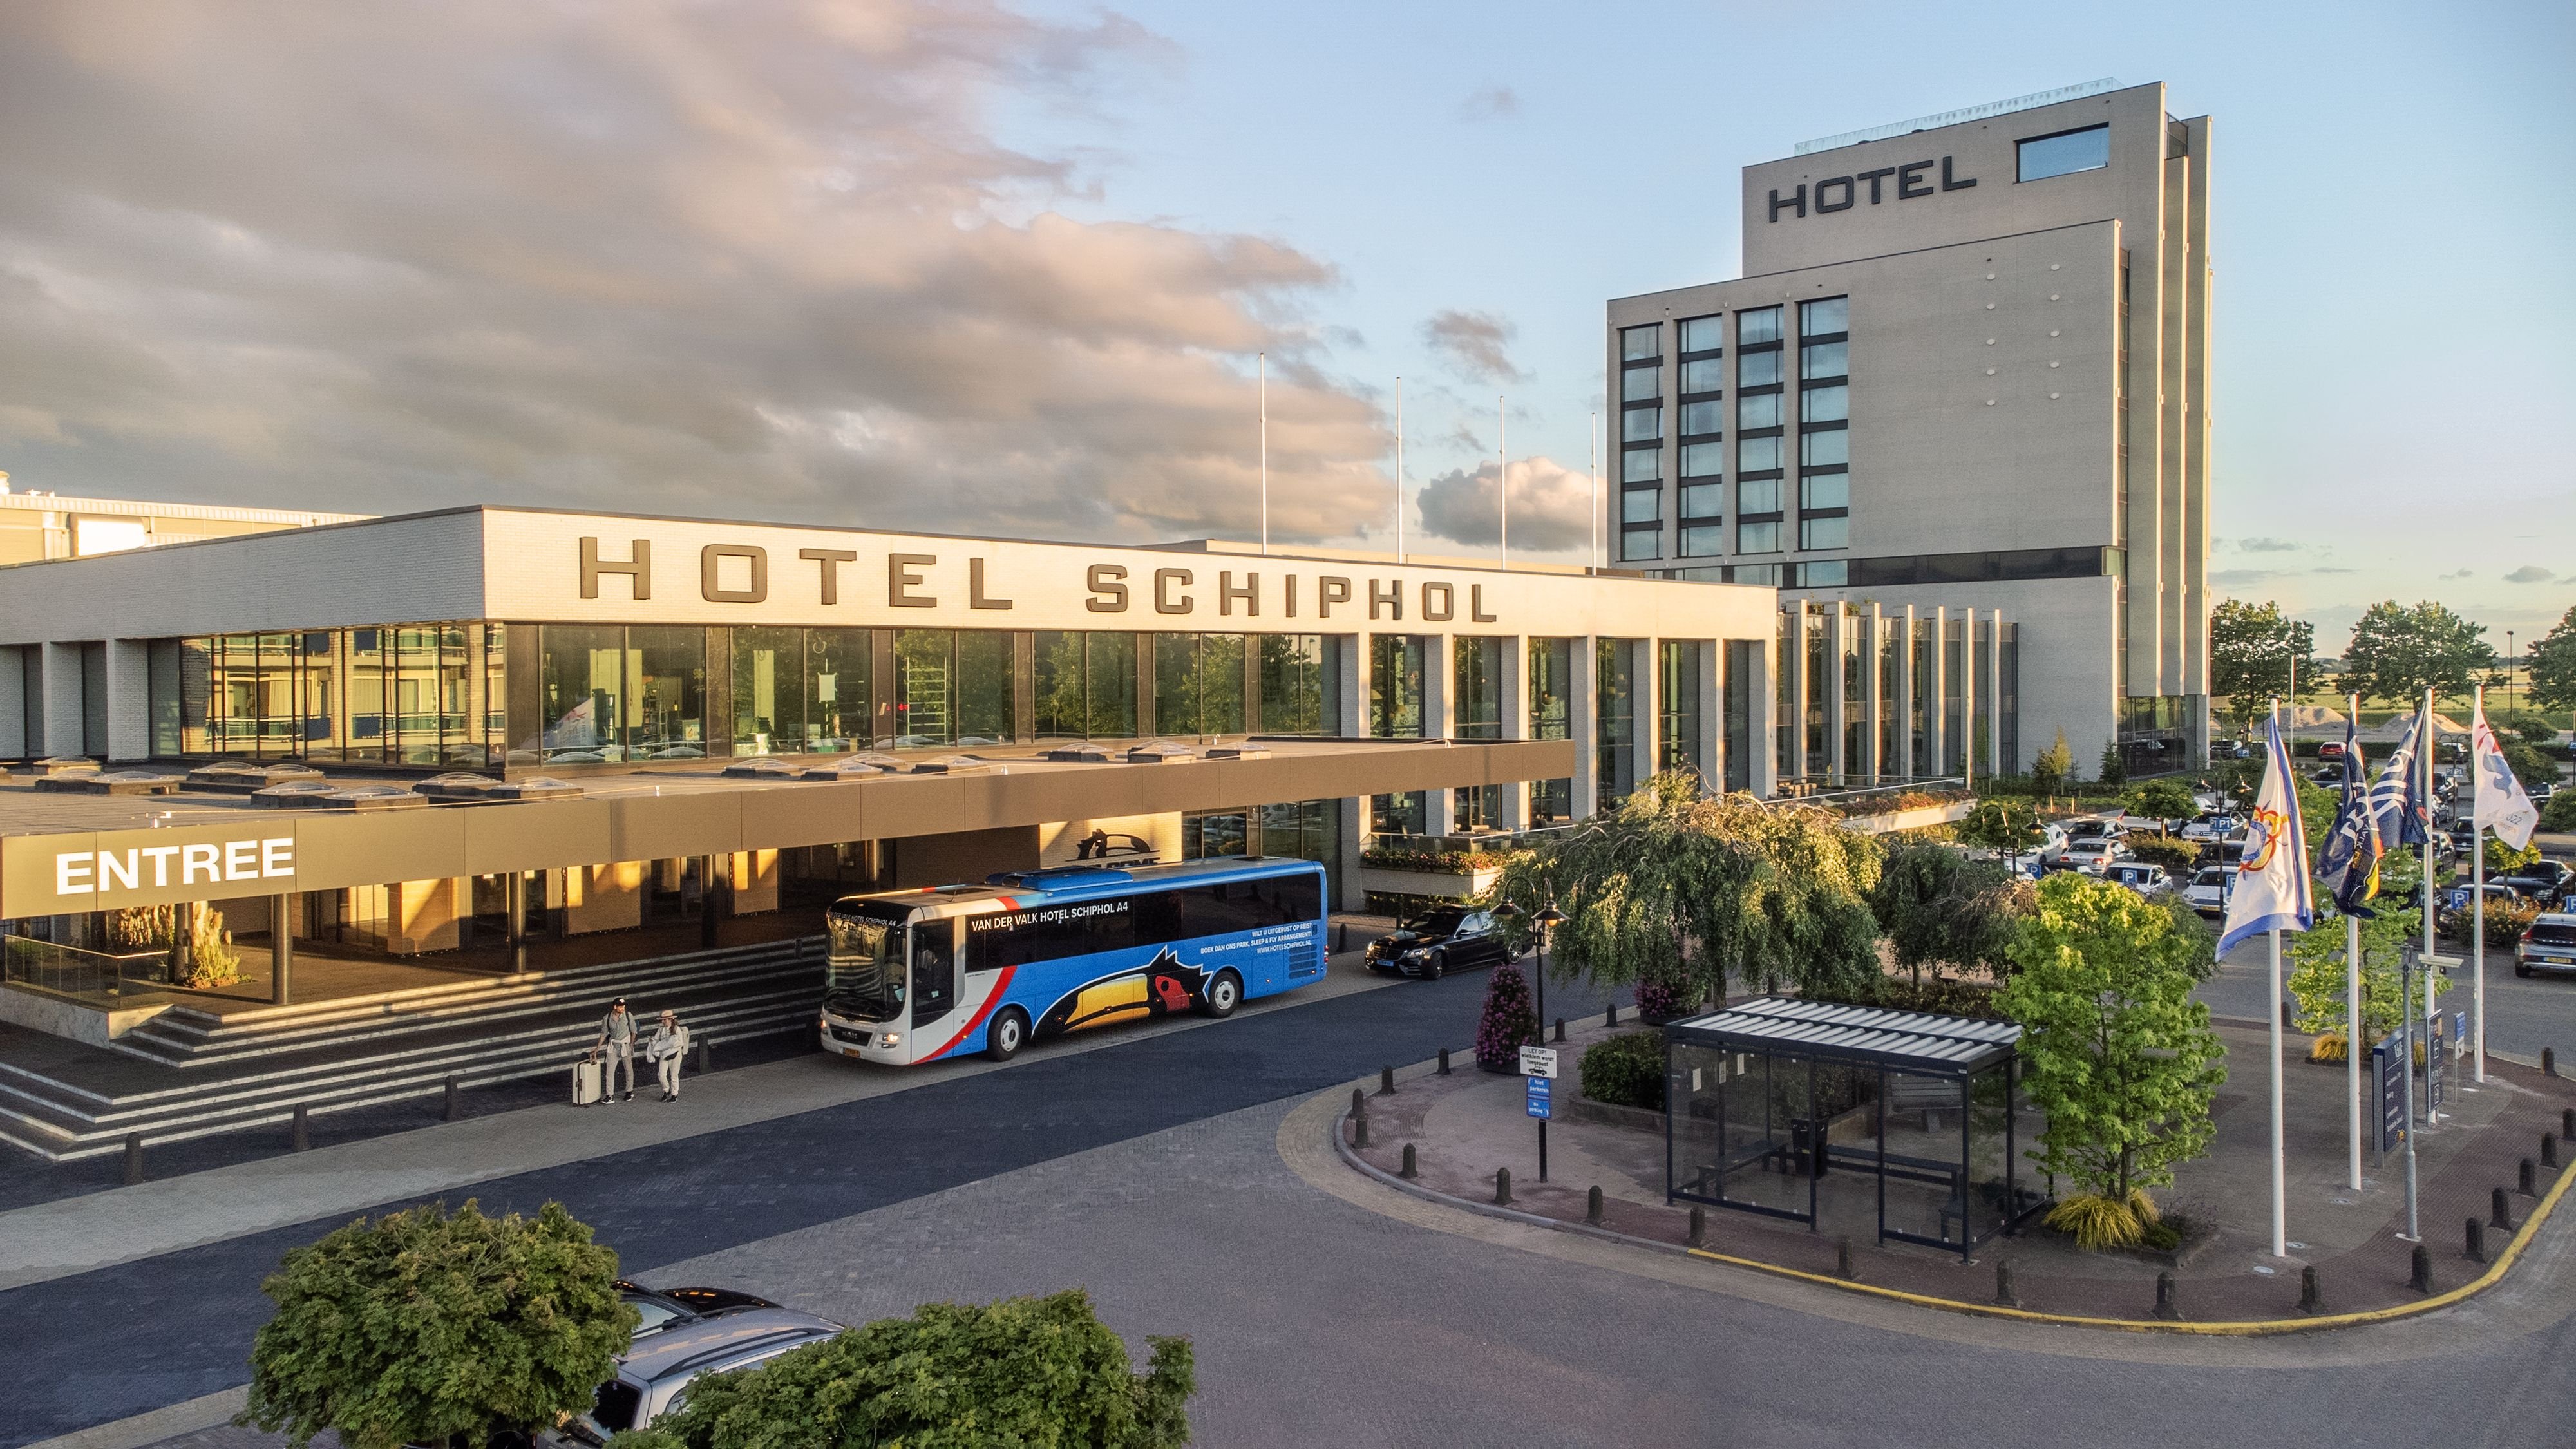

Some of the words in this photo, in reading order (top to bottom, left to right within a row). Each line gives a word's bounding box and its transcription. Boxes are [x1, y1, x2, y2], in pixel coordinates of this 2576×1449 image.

[1768, 155, 1977, 223] HOTEL
[579, 536, 1013, 610] HOTEL
[1085, 564, 1497, 623] SCHIPHOL
[2210, 819, 2217, 828] P1
[2219, 819, 2230, 828] P1
[56, 837, 294, 895] ENTREE
[2125, 872, 2134, 882] P
[2454, 893, 2465, 904] P
[866, 916, 887, 925] SCHIPHOL
[972, 920, 992, 931] VAN
[994, 916, 1012, 929] DER
[1015, 913, 1038, 926] VALK
[1040, 909, 1069, 922] HOTEL
[1071, 904, 1115, 919] SCHIPHOL
[1117, 901, 1128, 912] A4
[1267, 925, 1293, 935] UITGERUST
[1256, 940, 1312, 954] WWW.HOTELSCHIPHOL.NL
